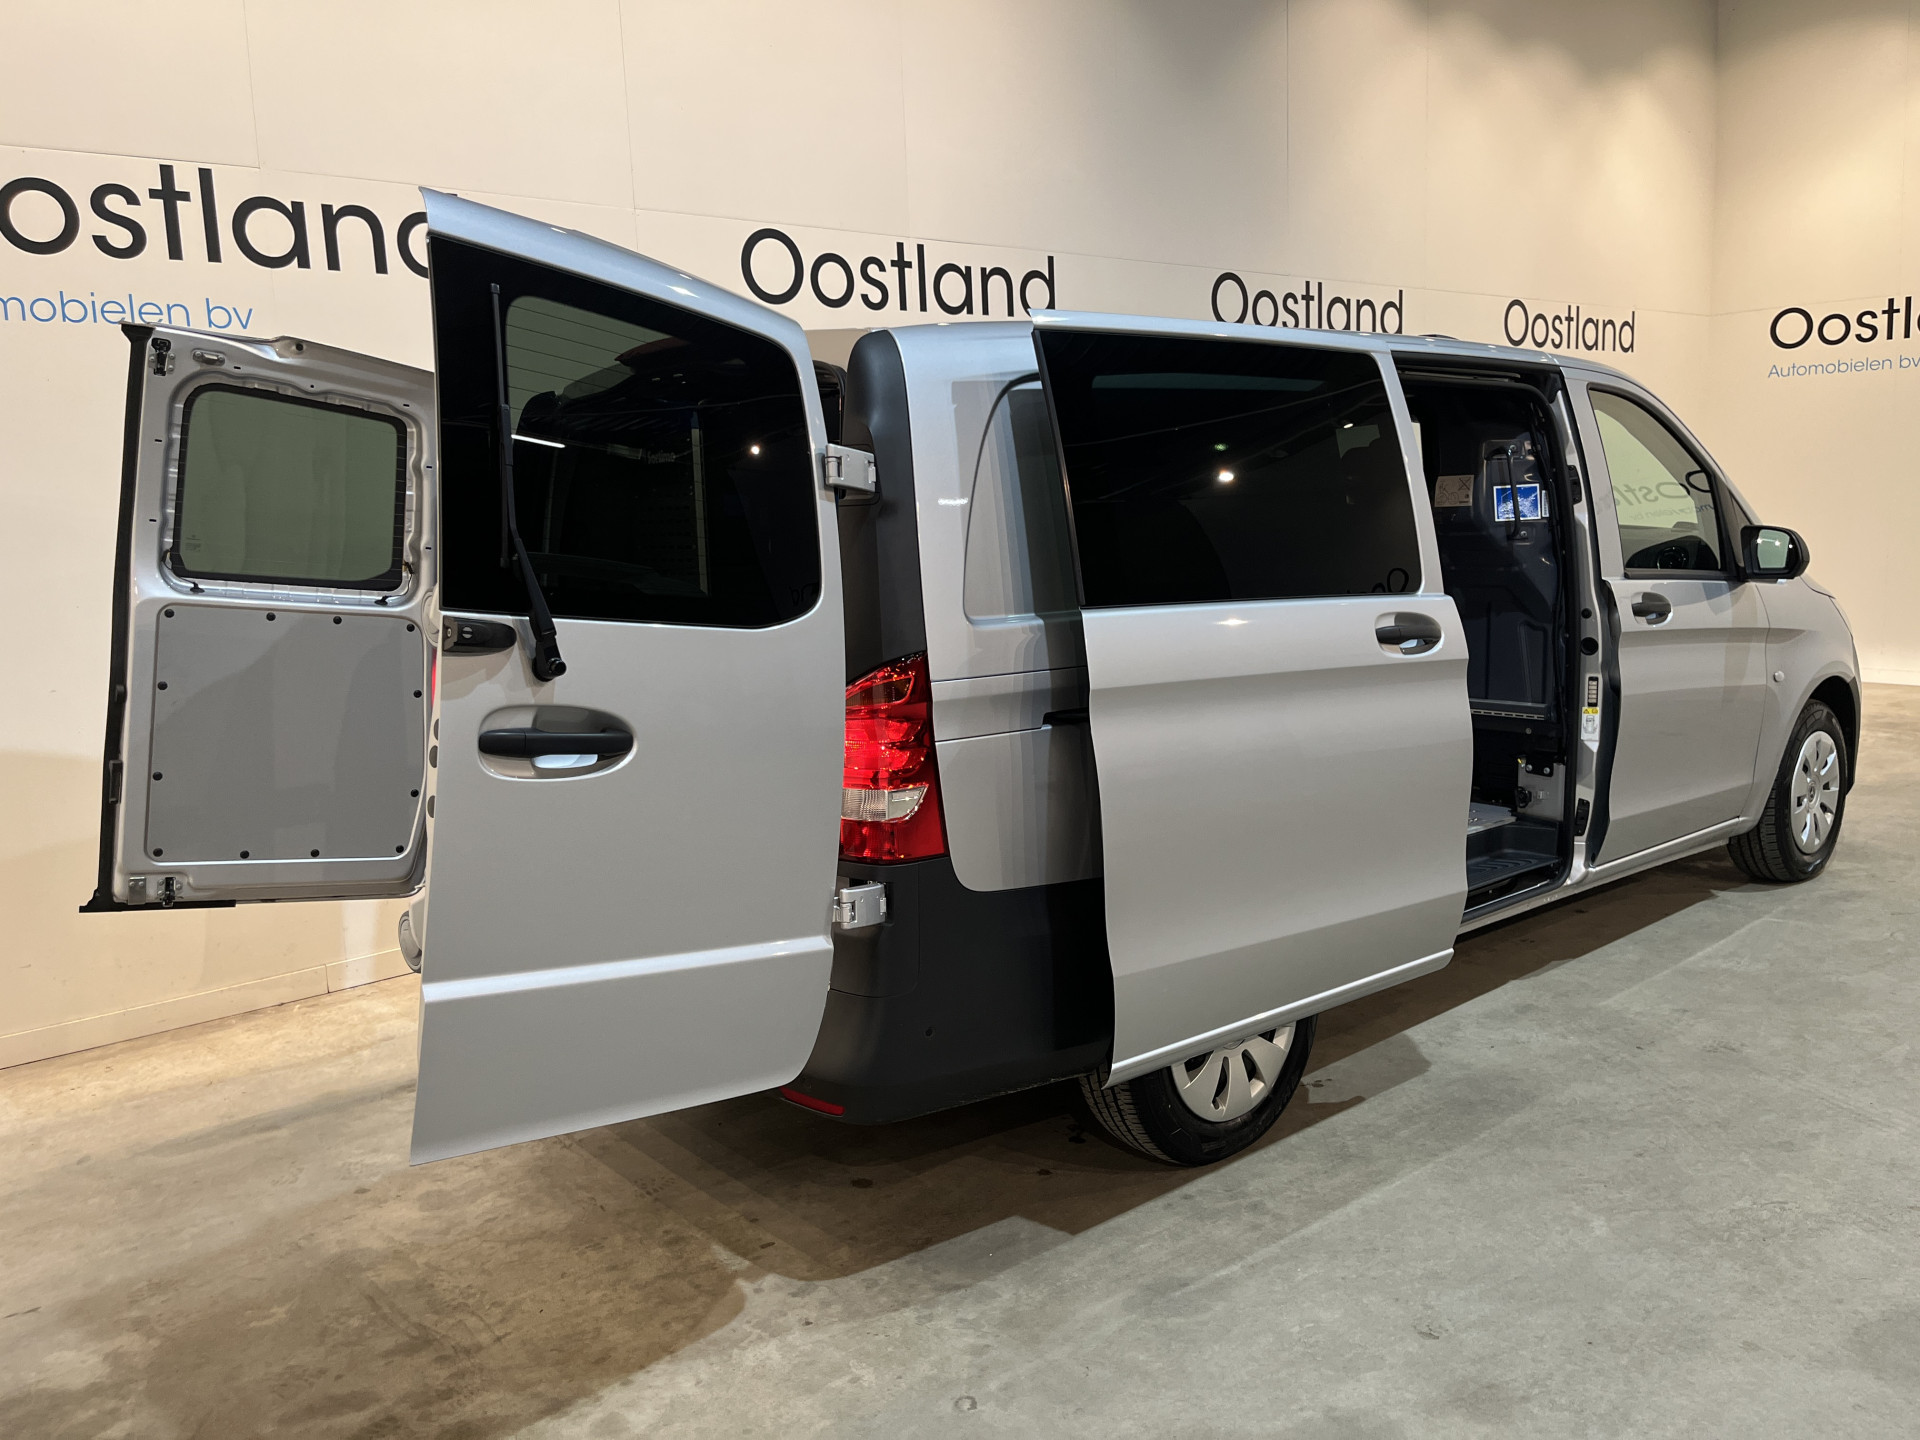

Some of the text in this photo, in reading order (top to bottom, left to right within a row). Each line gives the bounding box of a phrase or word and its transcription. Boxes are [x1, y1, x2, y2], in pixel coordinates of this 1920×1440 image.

[741, 227, 1056, 318] Oostland
[206, 297, 254, 330] bv
[1211, 272, 1404, 334] Oostland
[1504, 299, 1636, 353] Oostland
[1769, 296, 1920, 350] Oostl
[1768, 354, 1920, 378] Automobielen bv
